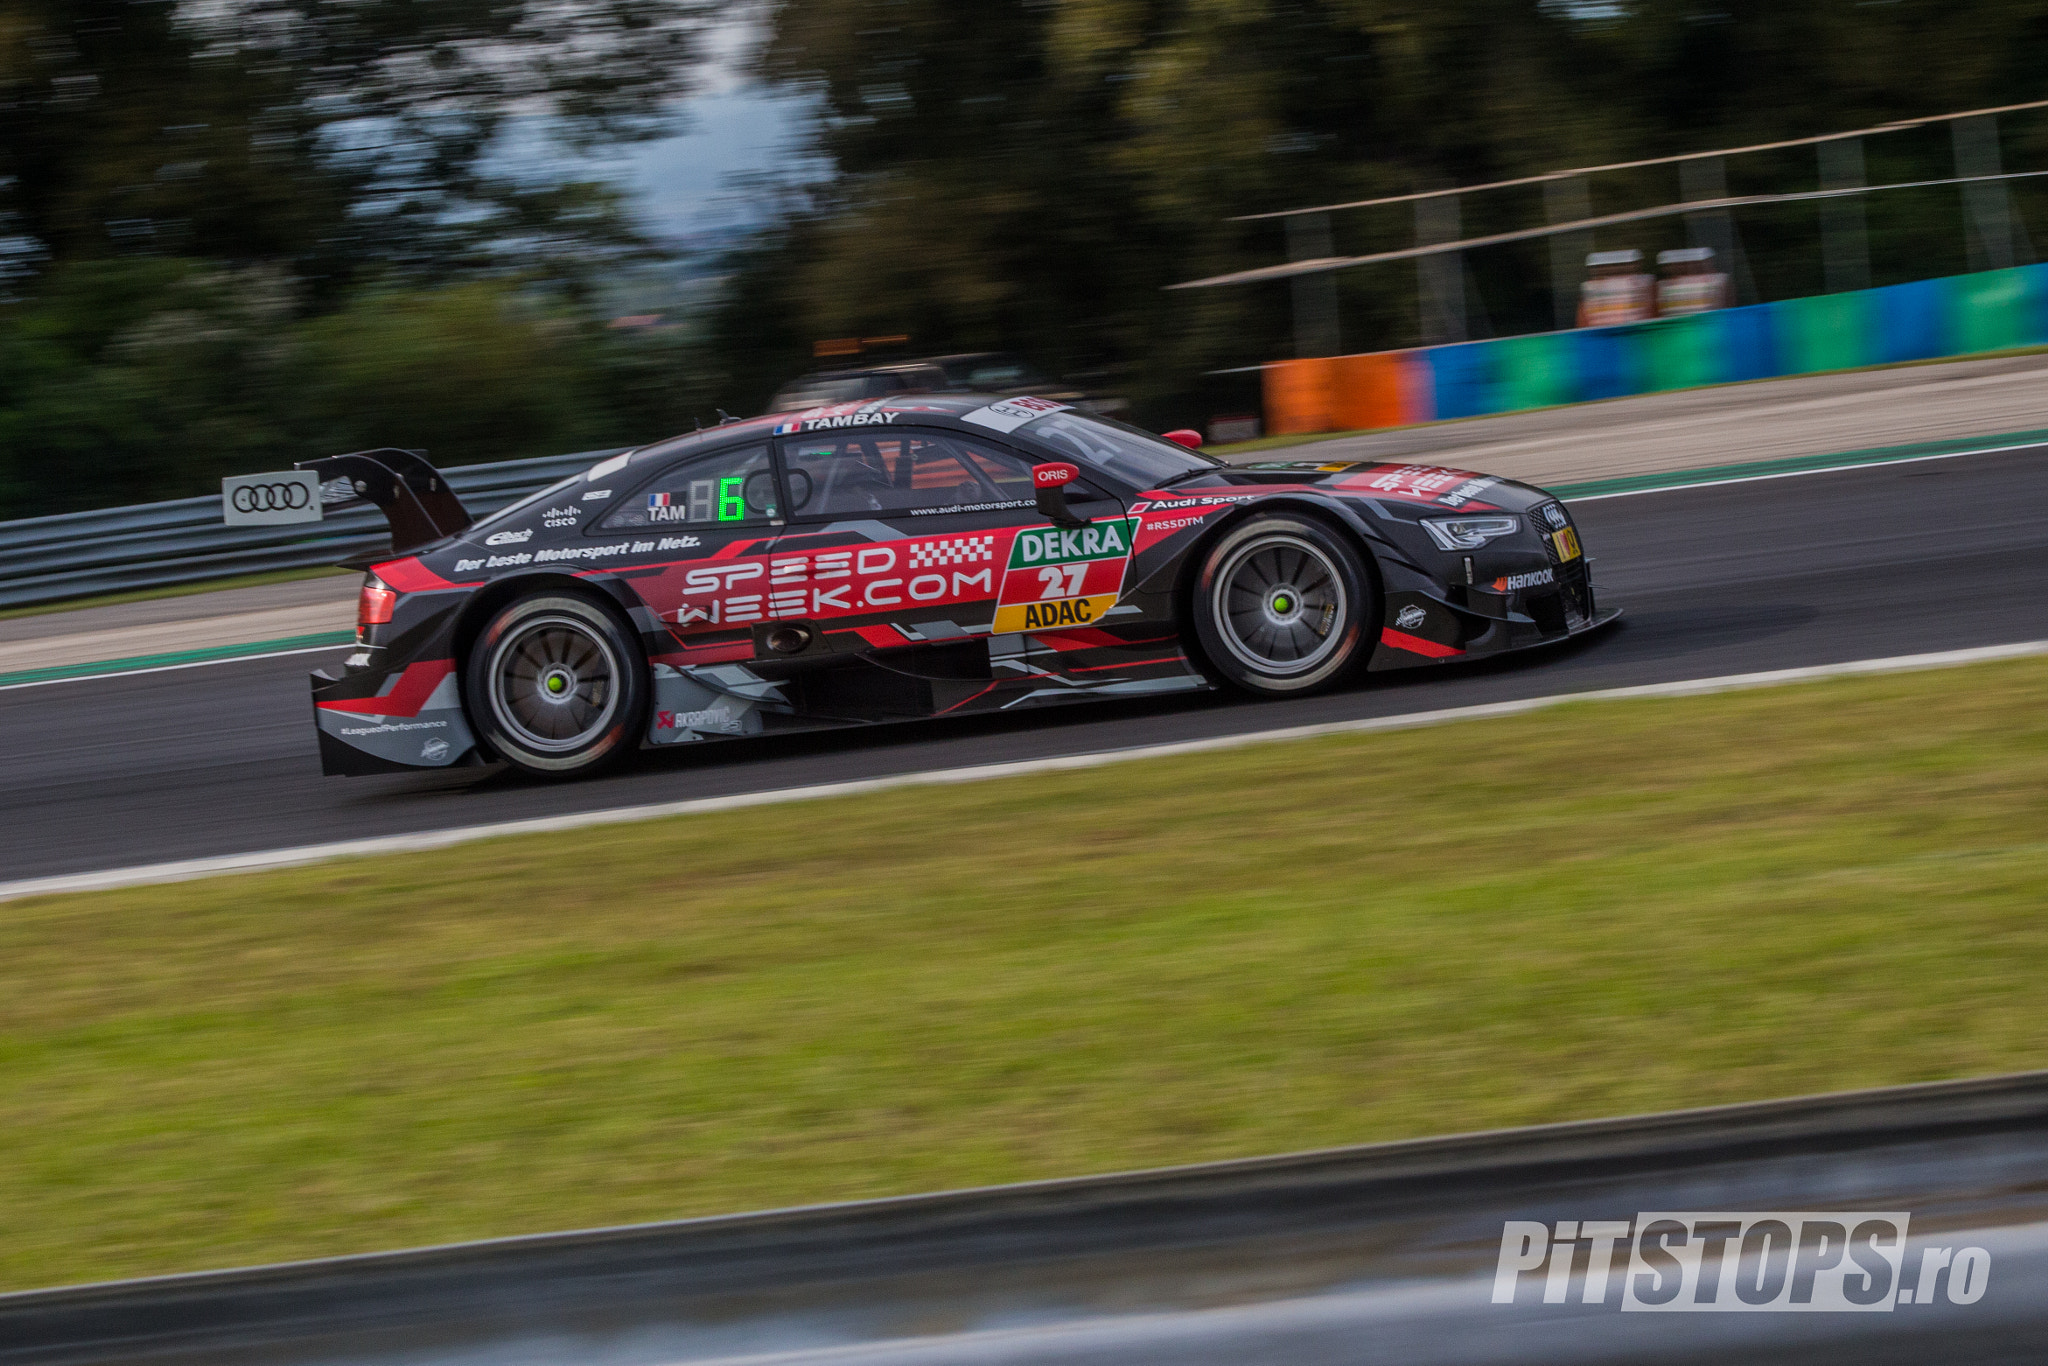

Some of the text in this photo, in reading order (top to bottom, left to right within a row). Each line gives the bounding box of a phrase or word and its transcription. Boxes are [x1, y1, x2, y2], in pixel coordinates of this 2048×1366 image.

[805, 412, 900, 430] TAMBAY
[1038, 469, 1069, 482] ORIS
[648, 505, 686, 521] TAM
[718, 477, 745, 522] 6
[910, 499, 1037, 516] www.audi-motorsport.co
[1152, 495, 1256, 510] Audi Sport
[1146, 516, 1204, 531] #RS5DTM
[454, 535, 701, 572] Der beste Motorsport im Netz.
[1021, 525, 1125, 562] DEKRA
[682, 547, 896, 595] SPEED
[1038, 563, 1090, 599] 27
[677, 568, 992, 626] WEEK.COM
[1025, 598, 1092, 628] ADAC
